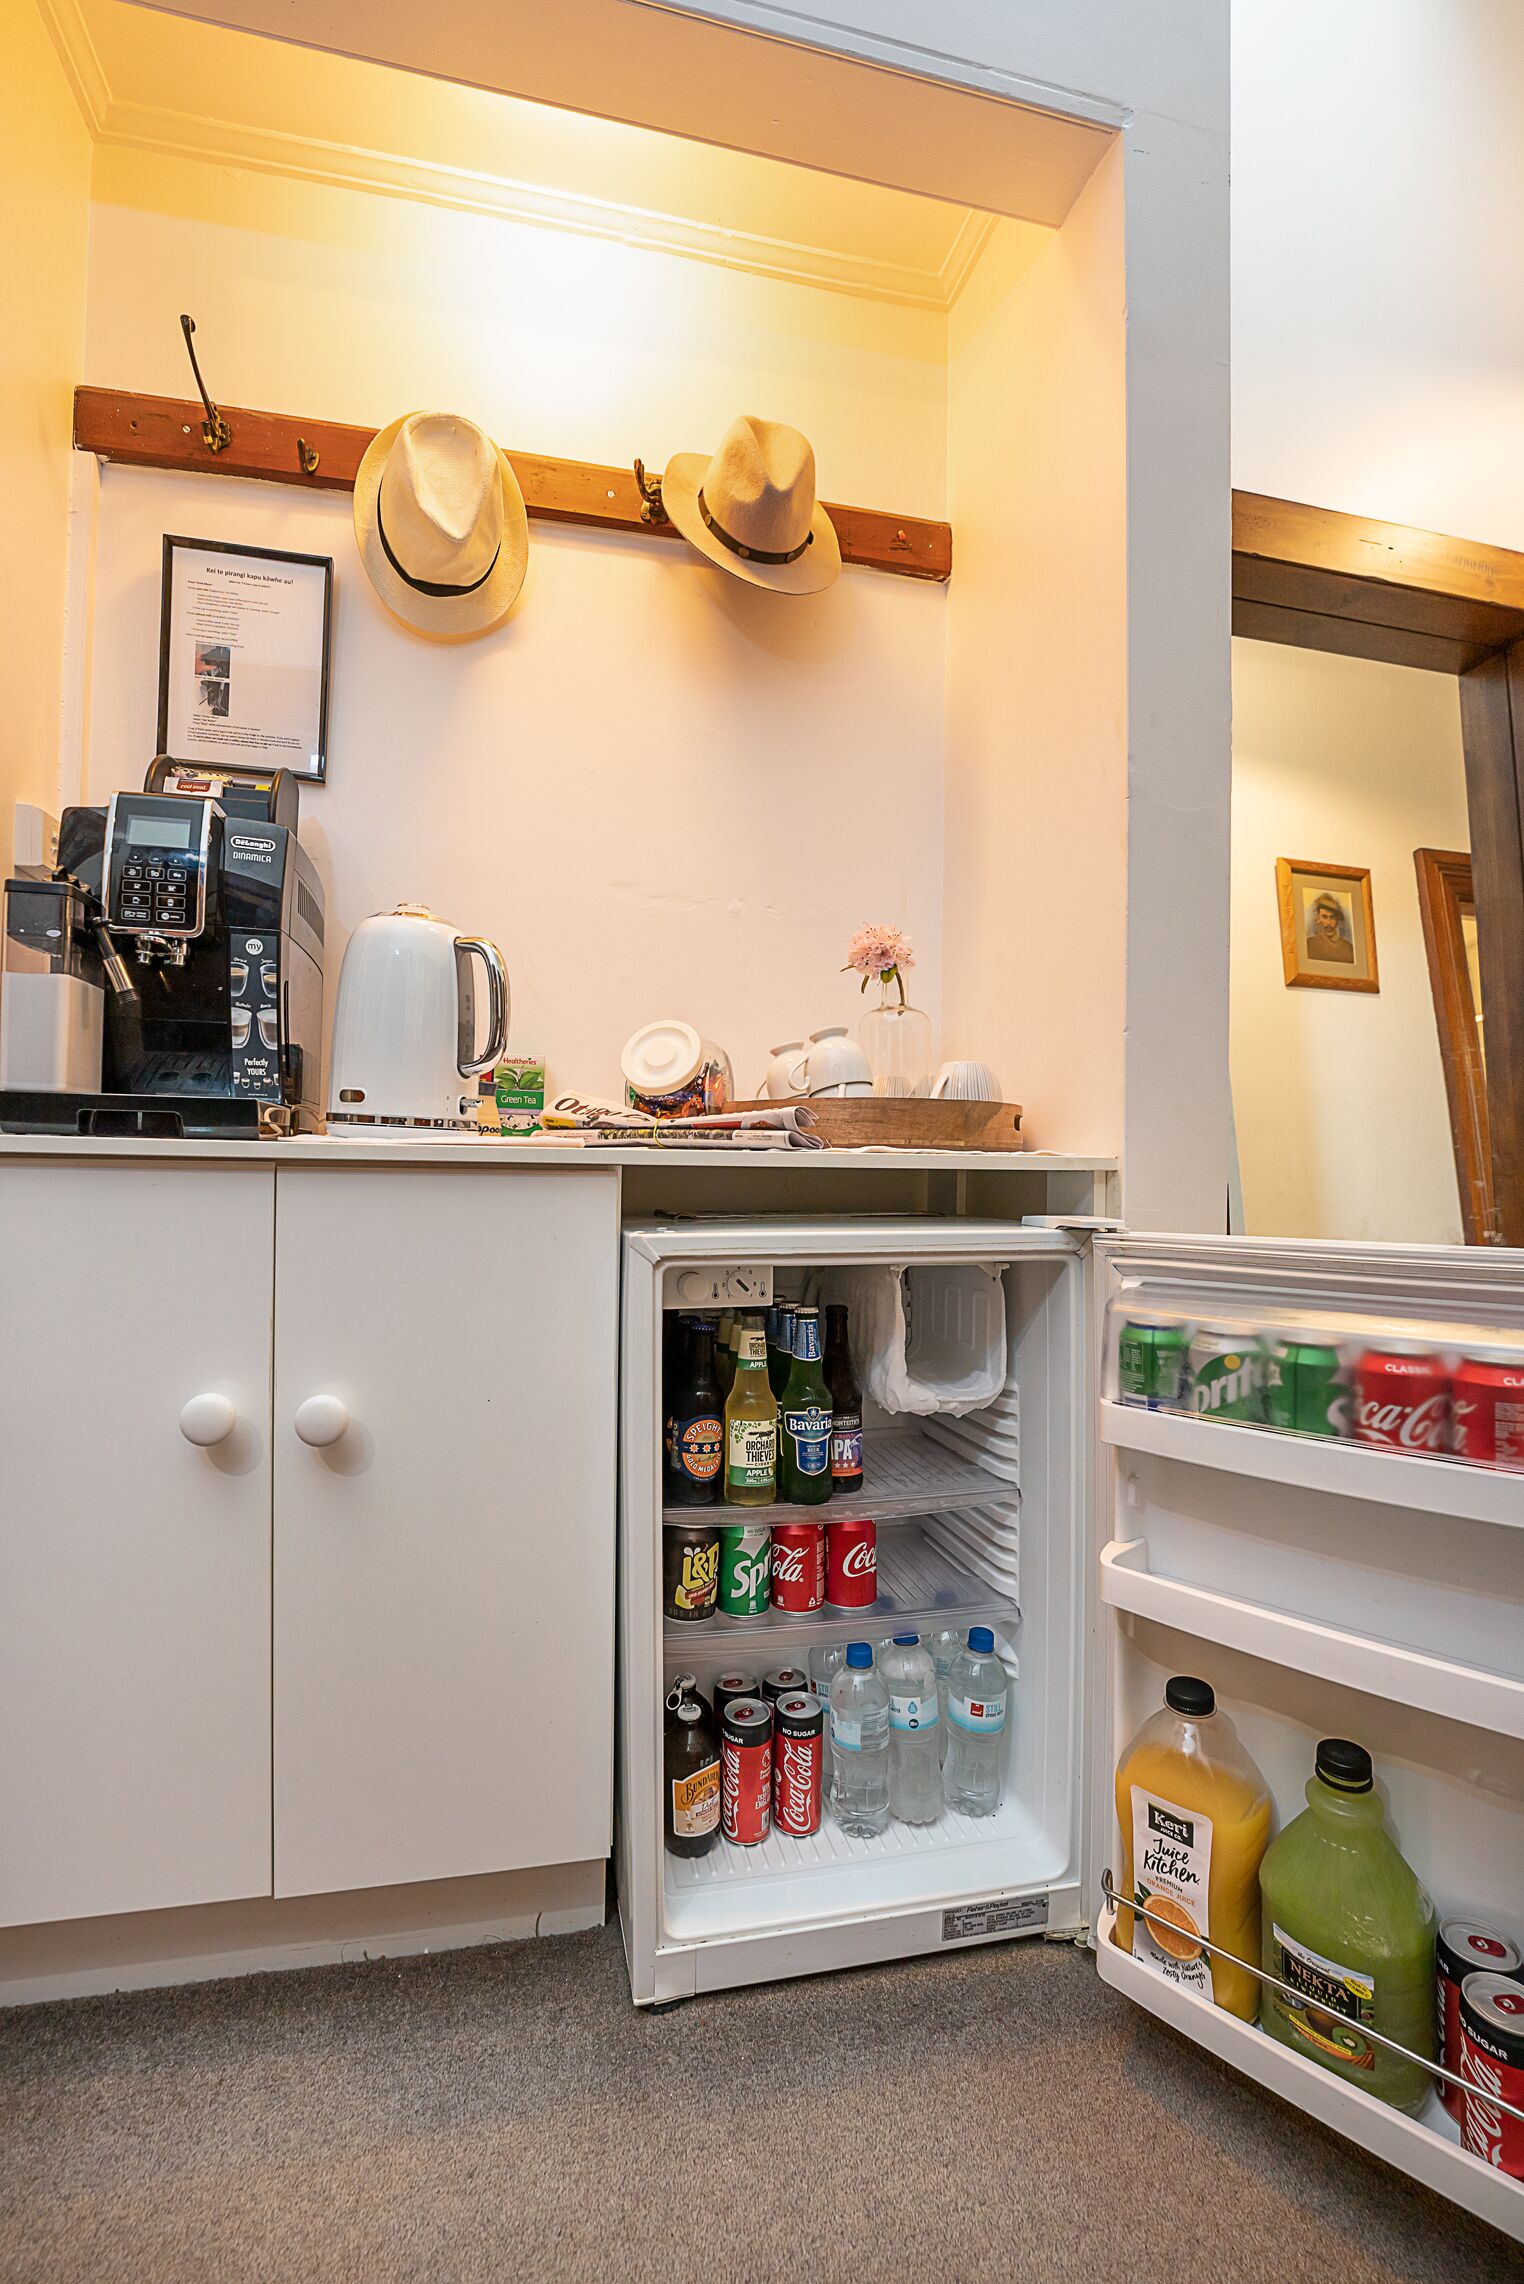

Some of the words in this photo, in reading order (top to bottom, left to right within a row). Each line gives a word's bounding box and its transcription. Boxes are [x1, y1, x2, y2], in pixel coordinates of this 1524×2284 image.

[225, 570, 246, 579] pirangi
[246, 573, 262, 581] kapu
[233, 851, 272, 864] DINAMICA
[247, 943, 262, 951] my
[244, 1057, 269, 1068] Perfectly
[246, 1067, 267, 1076] YOURS
[500, 1095, 522, 1104] Green
[523, 1096, 537, 1105] Tea
[808, 1324, 816, 1358] Bavaria
[1384, 1363, 1431, 1375] CLASSIC
[789, 1417, 832, 1431] Bavaria
[697, 1464, 717, 1473] MEDAL
[782, 1727, 792, 1736] NO
[793, 1729, 816, 1738] SUGAR
[1153, 1810, 1190, 1838] Keri
[1160, 1827, 1174, 1838] JUICE
[1152, 1838, 1190, 1865] Juice
[1143, 1849, 1200, 1884] Kitchen
[1155, 1875, 1183, 1894] PREMIUM
[1146, 1878, 1174, 1897] ORANGE
[1176, 1892, 1196, 1908] JUICE
[1150, 1951, 1167, 1966] made
[1167, 1961, 1181, 1971] with
[1289, 1958, 1349, 2003] NEKTA
[1467, 2026, 1509, 2061] SUGAR
